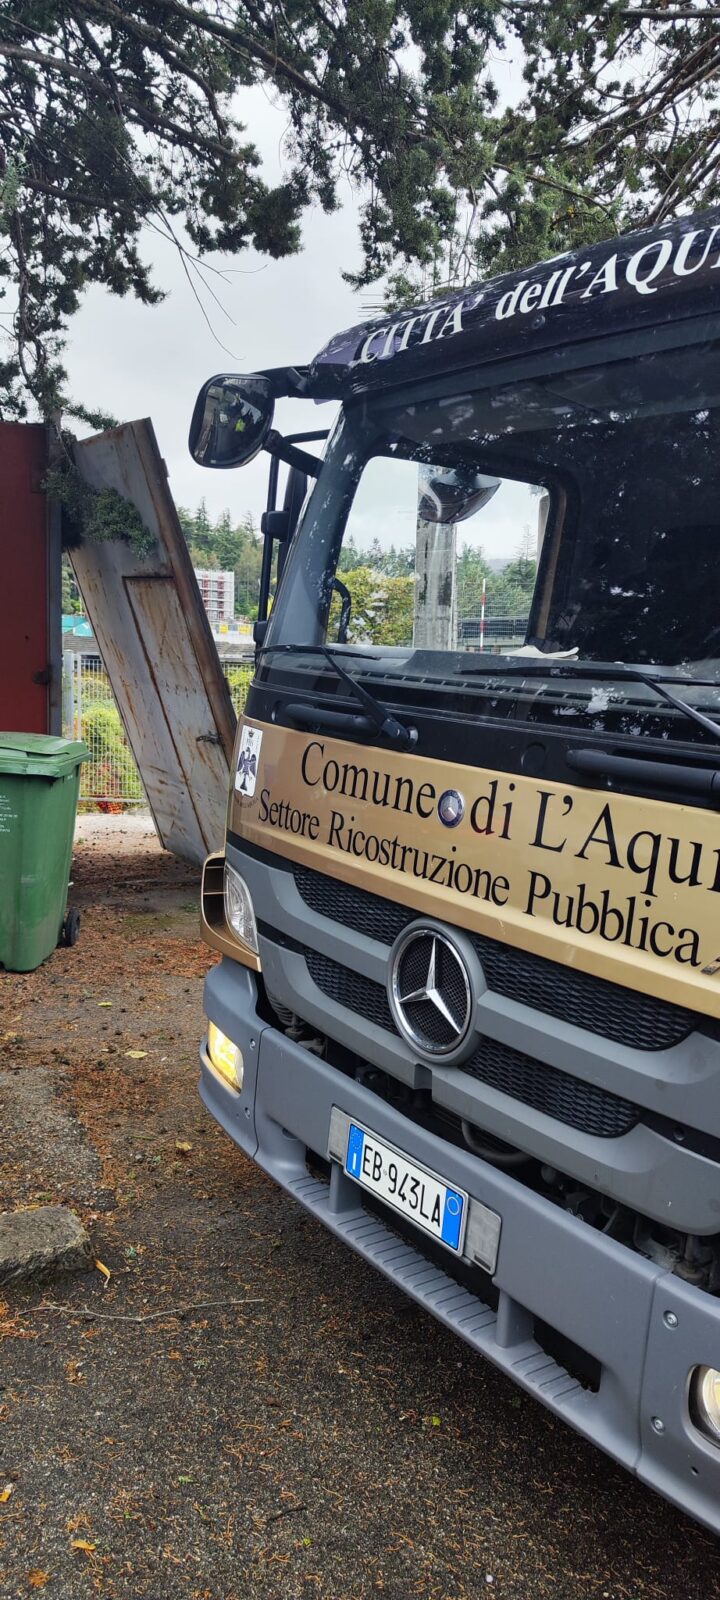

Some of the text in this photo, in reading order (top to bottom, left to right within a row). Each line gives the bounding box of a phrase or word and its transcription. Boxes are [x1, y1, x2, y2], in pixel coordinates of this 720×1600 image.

[495, 225, 720, 320] dell'AQU
[301, 741, 436, 819] Comune
[470, 780, 515, 840] di
[258, 788, 701, 967] Settore Ricostruzione Pubblica
[362, 1144, 383, 1182] EB
[388, 1163, 442, 1228] 943LA
